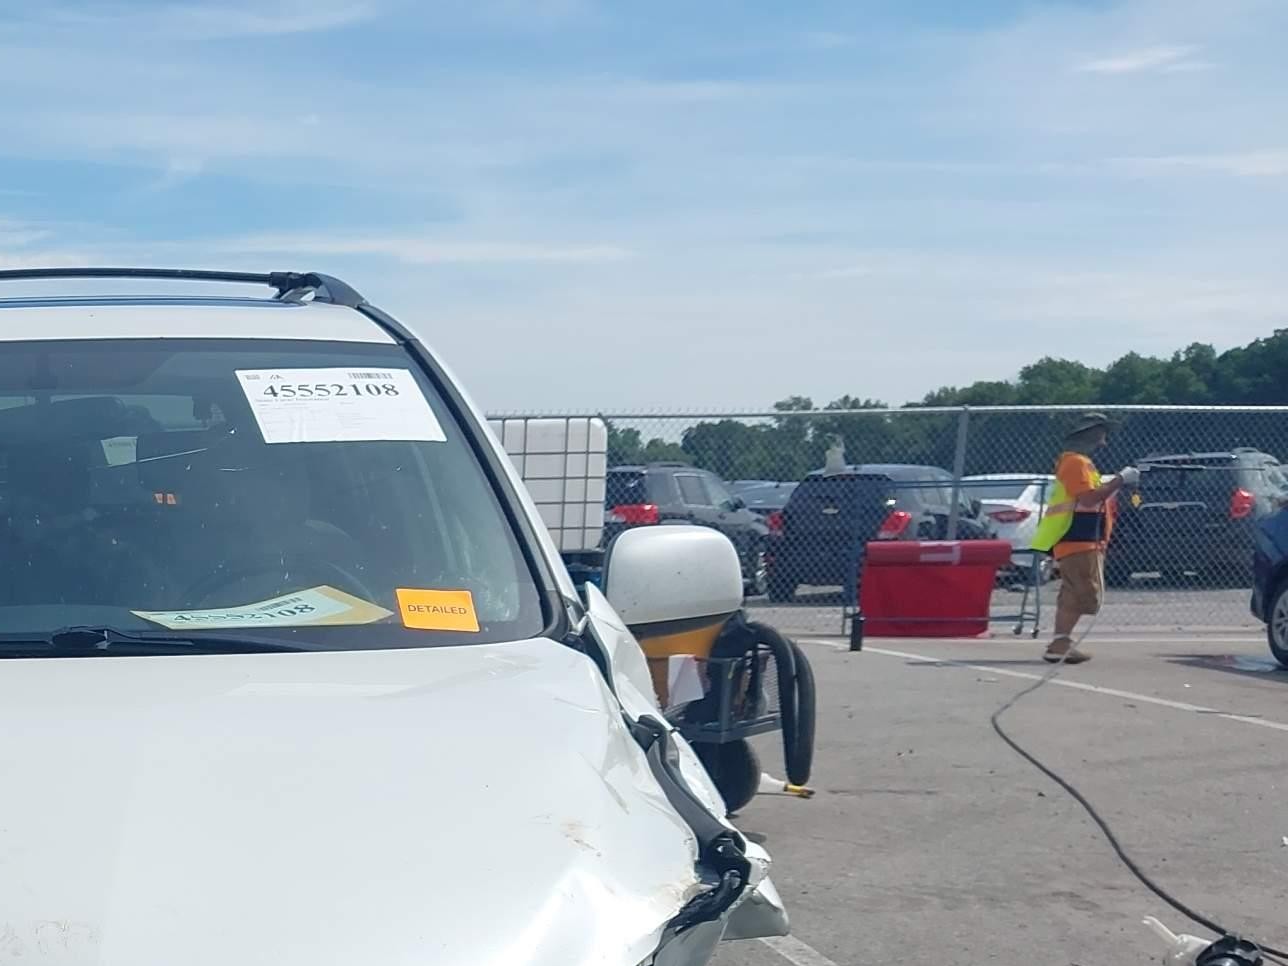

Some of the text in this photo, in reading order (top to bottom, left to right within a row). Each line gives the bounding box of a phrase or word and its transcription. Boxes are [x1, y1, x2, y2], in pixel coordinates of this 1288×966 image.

[263, 384, 400, 398] 45552108
[174, 604, 316, 622] 45552108
[407, 604, 468, 615] DETAILED
